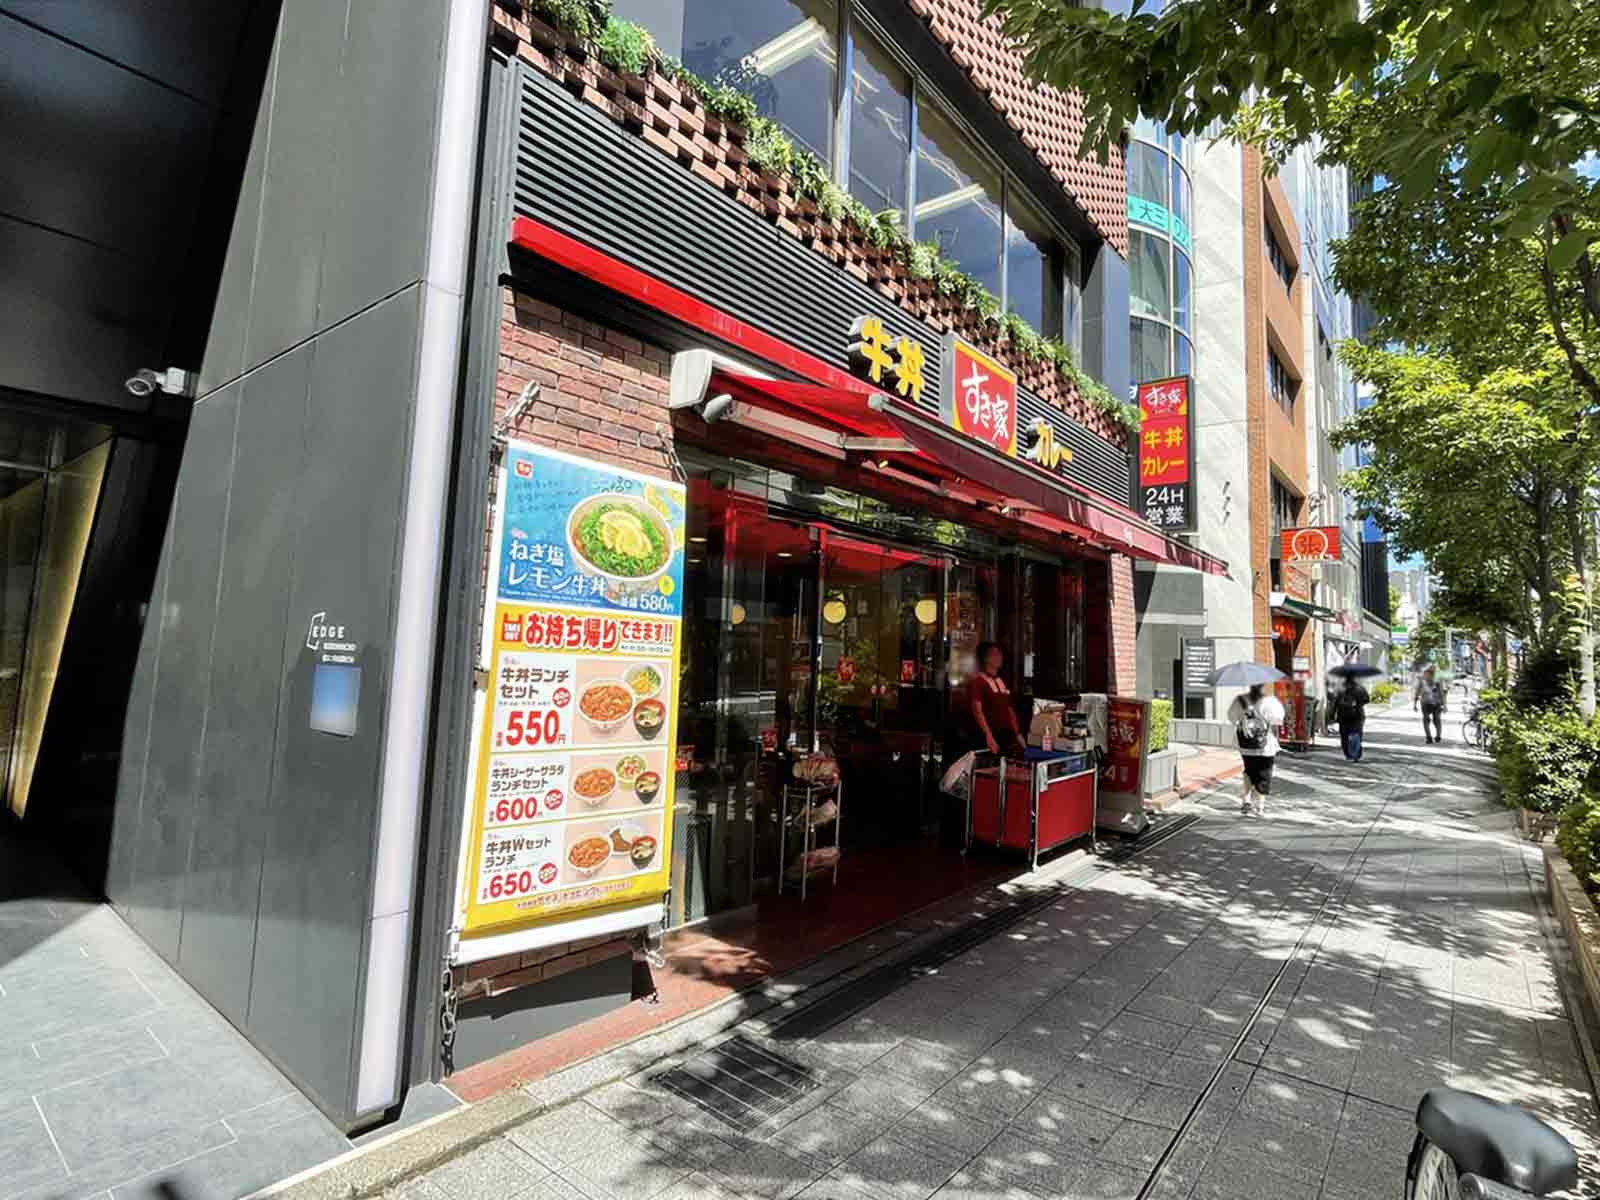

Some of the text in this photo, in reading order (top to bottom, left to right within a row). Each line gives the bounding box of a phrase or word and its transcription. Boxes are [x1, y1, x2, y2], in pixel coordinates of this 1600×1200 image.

[861, 318, 926, 401] 牛丼
[962, 361, 1009, 441] すき家
[1145, 387, 1182, 407] すき家
[1035, 420, 1073, 470] カレー
[1144, 426, 1184, 449] 牛丼
[1143, 456, 1185, 477] カレー
[1146, 487, 1185, 506] 24H
[1146, 505, 1185, 526] 営業
[509, 540, 565, 567] ねぎ塩
[508, 562, 607, 598] レモン牛丼
[312, 625, 345, 639] EDGE
[501, 667, 569, 684] 牛丼ランチ
[500, 685, 540, 699] セット
[491, 779, 549, 793] ランチセット
[486, 837, 551, 855] 牛丼Wセット
[485, 854, 517, 869] ランチ
